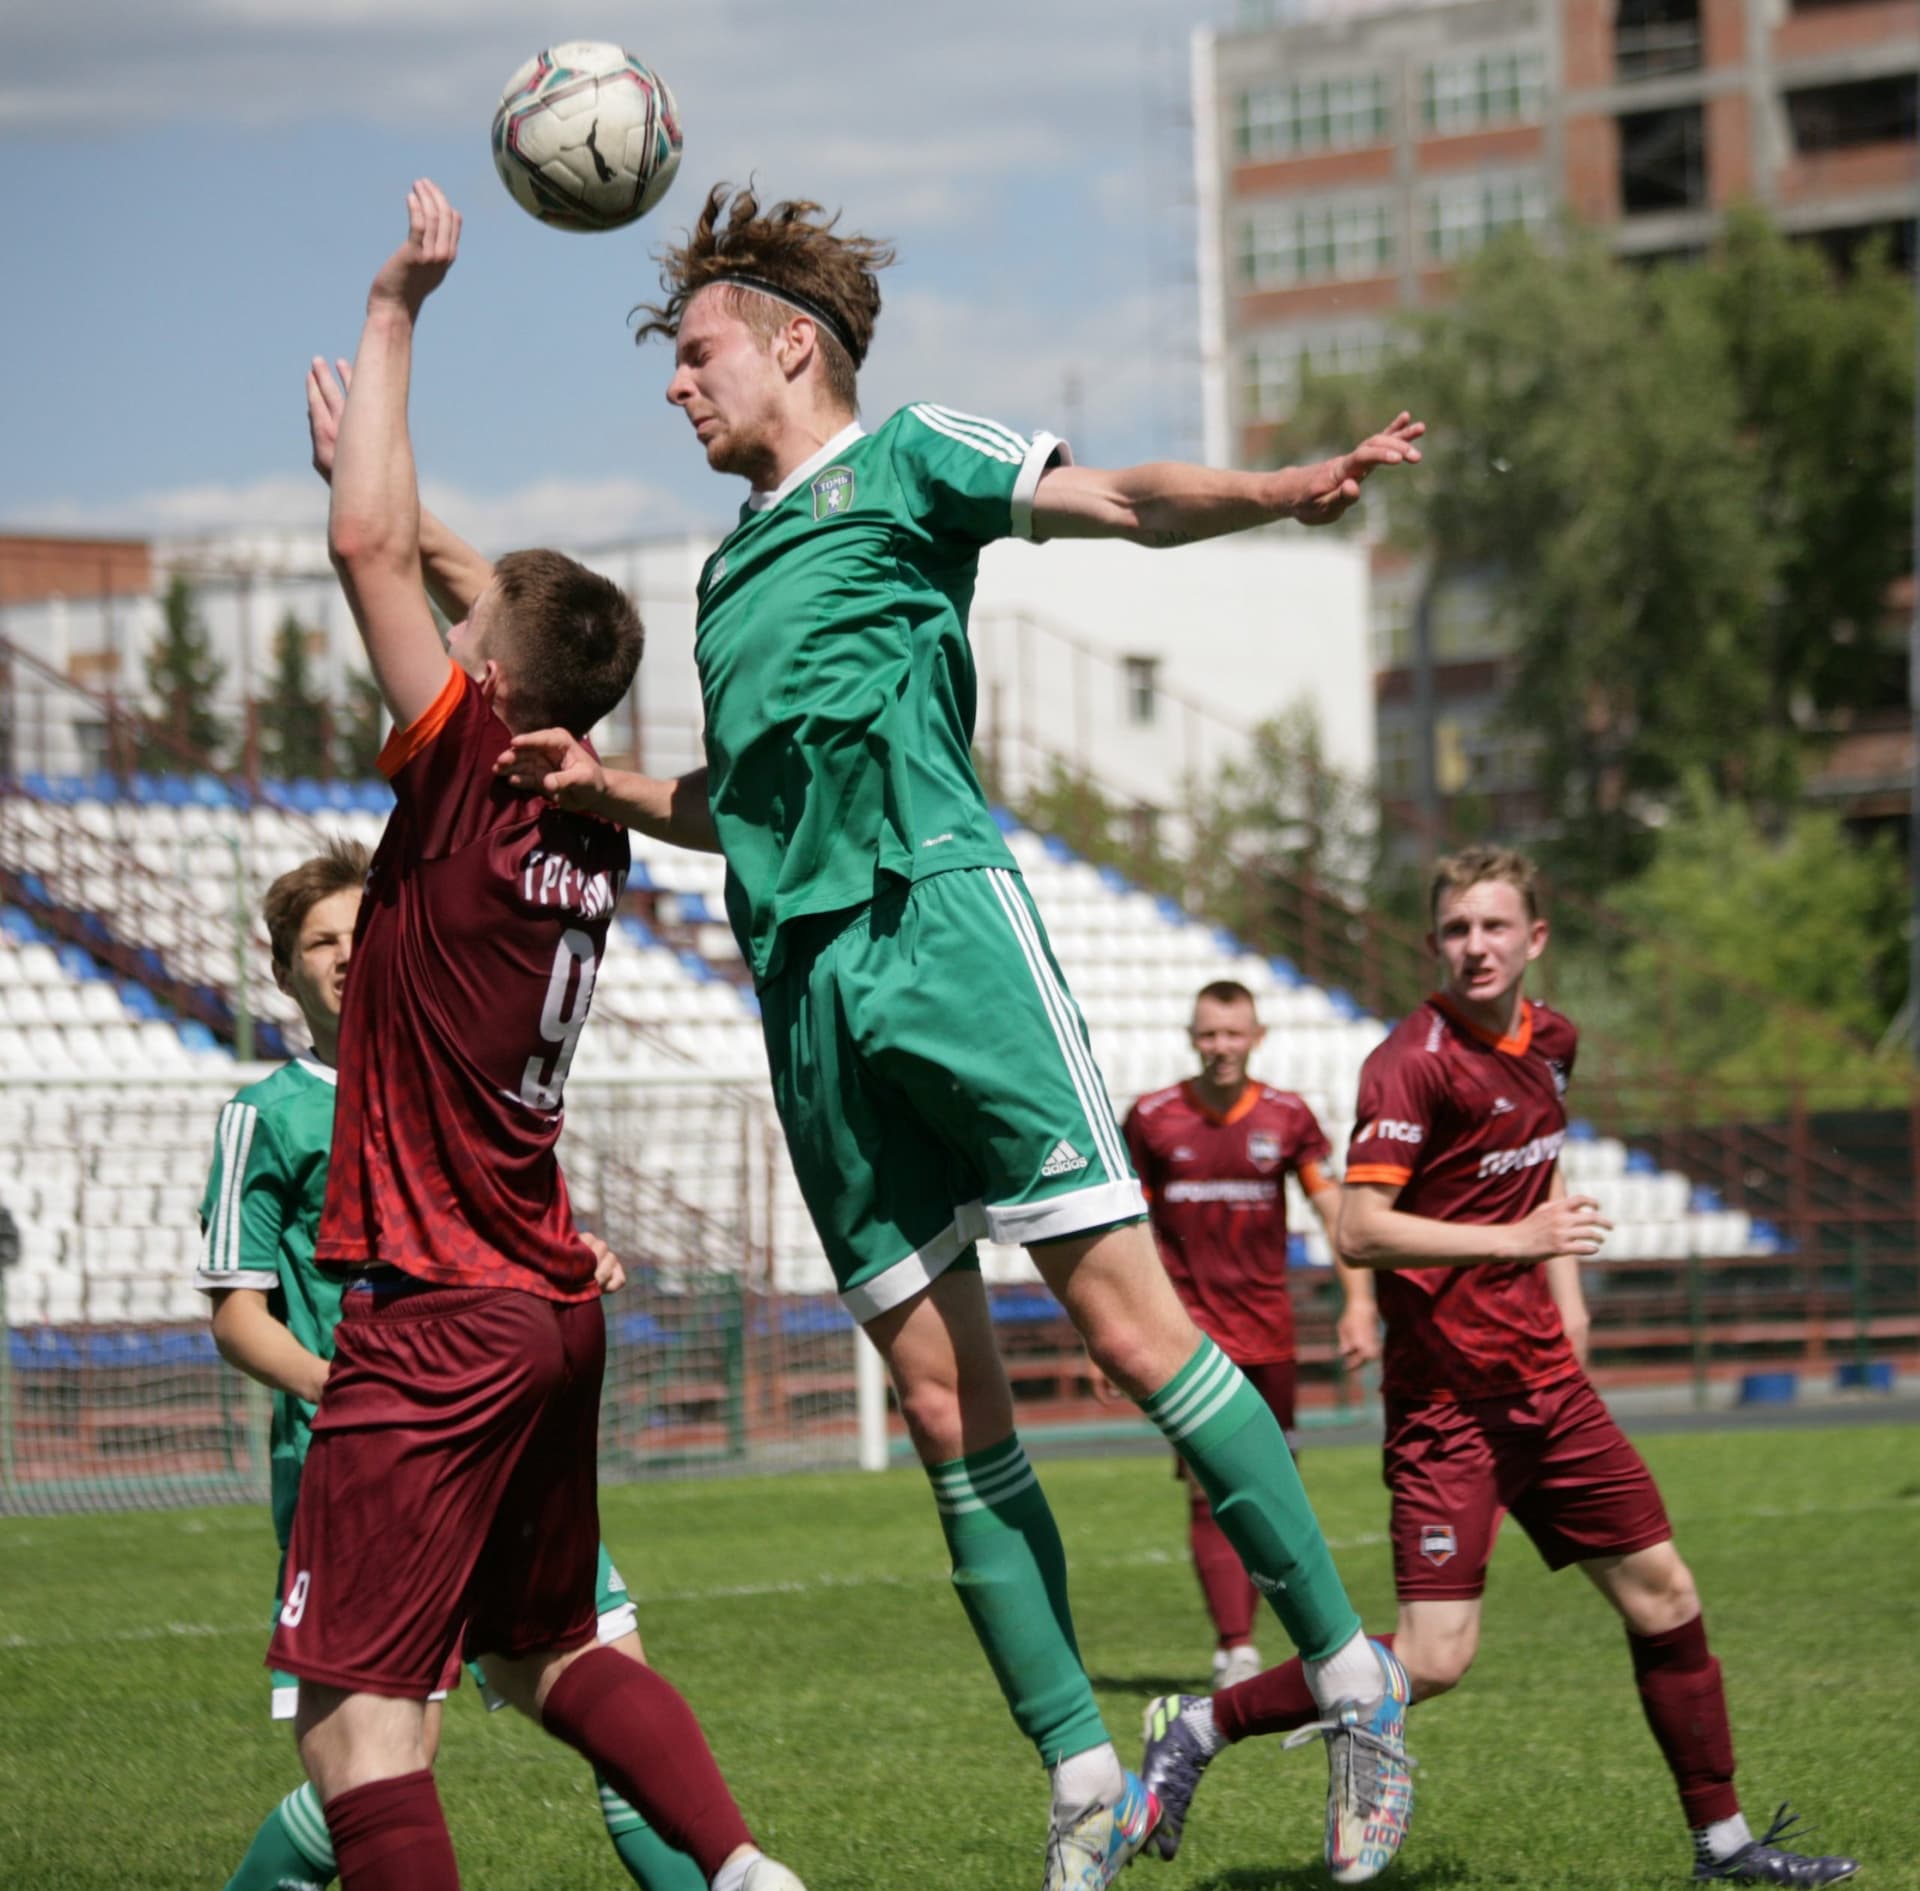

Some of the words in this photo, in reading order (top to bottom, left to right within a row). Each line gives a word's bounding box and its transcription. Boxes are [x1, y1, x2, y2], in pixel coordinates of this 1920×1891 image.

[520, 928, 595, 1110] 9
[1041, 1156, 1088, 1176] adidas
[280, 1570, 310, 1628] 9
